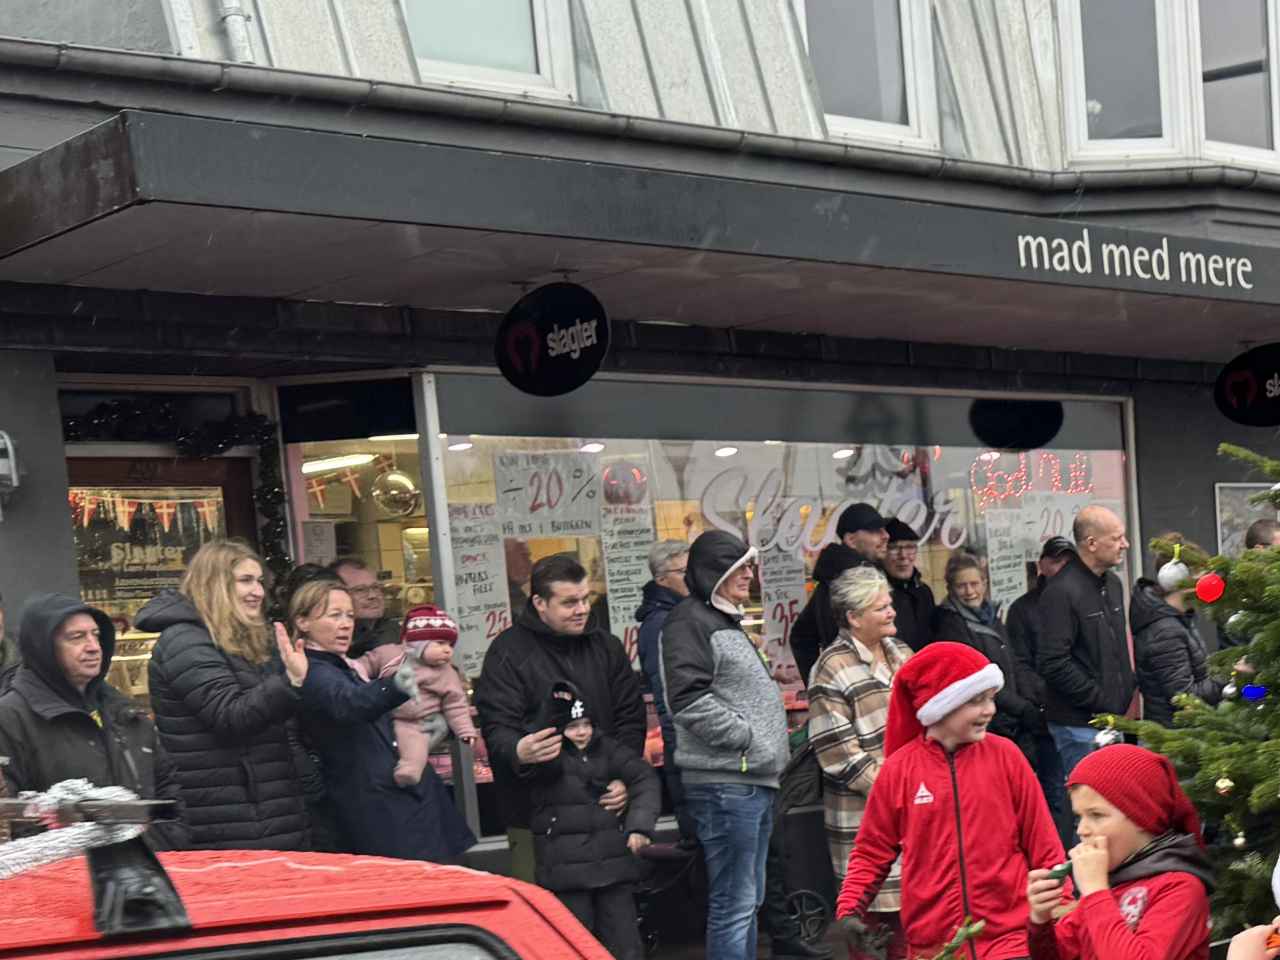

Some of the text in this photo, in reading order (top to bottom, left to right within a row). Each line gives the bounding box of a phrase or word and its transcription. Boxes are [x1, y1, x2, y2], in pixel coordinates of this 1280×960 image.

[1017, 228, 1253, 289] mad med mere
[547, 318, 598, 359] slagter
